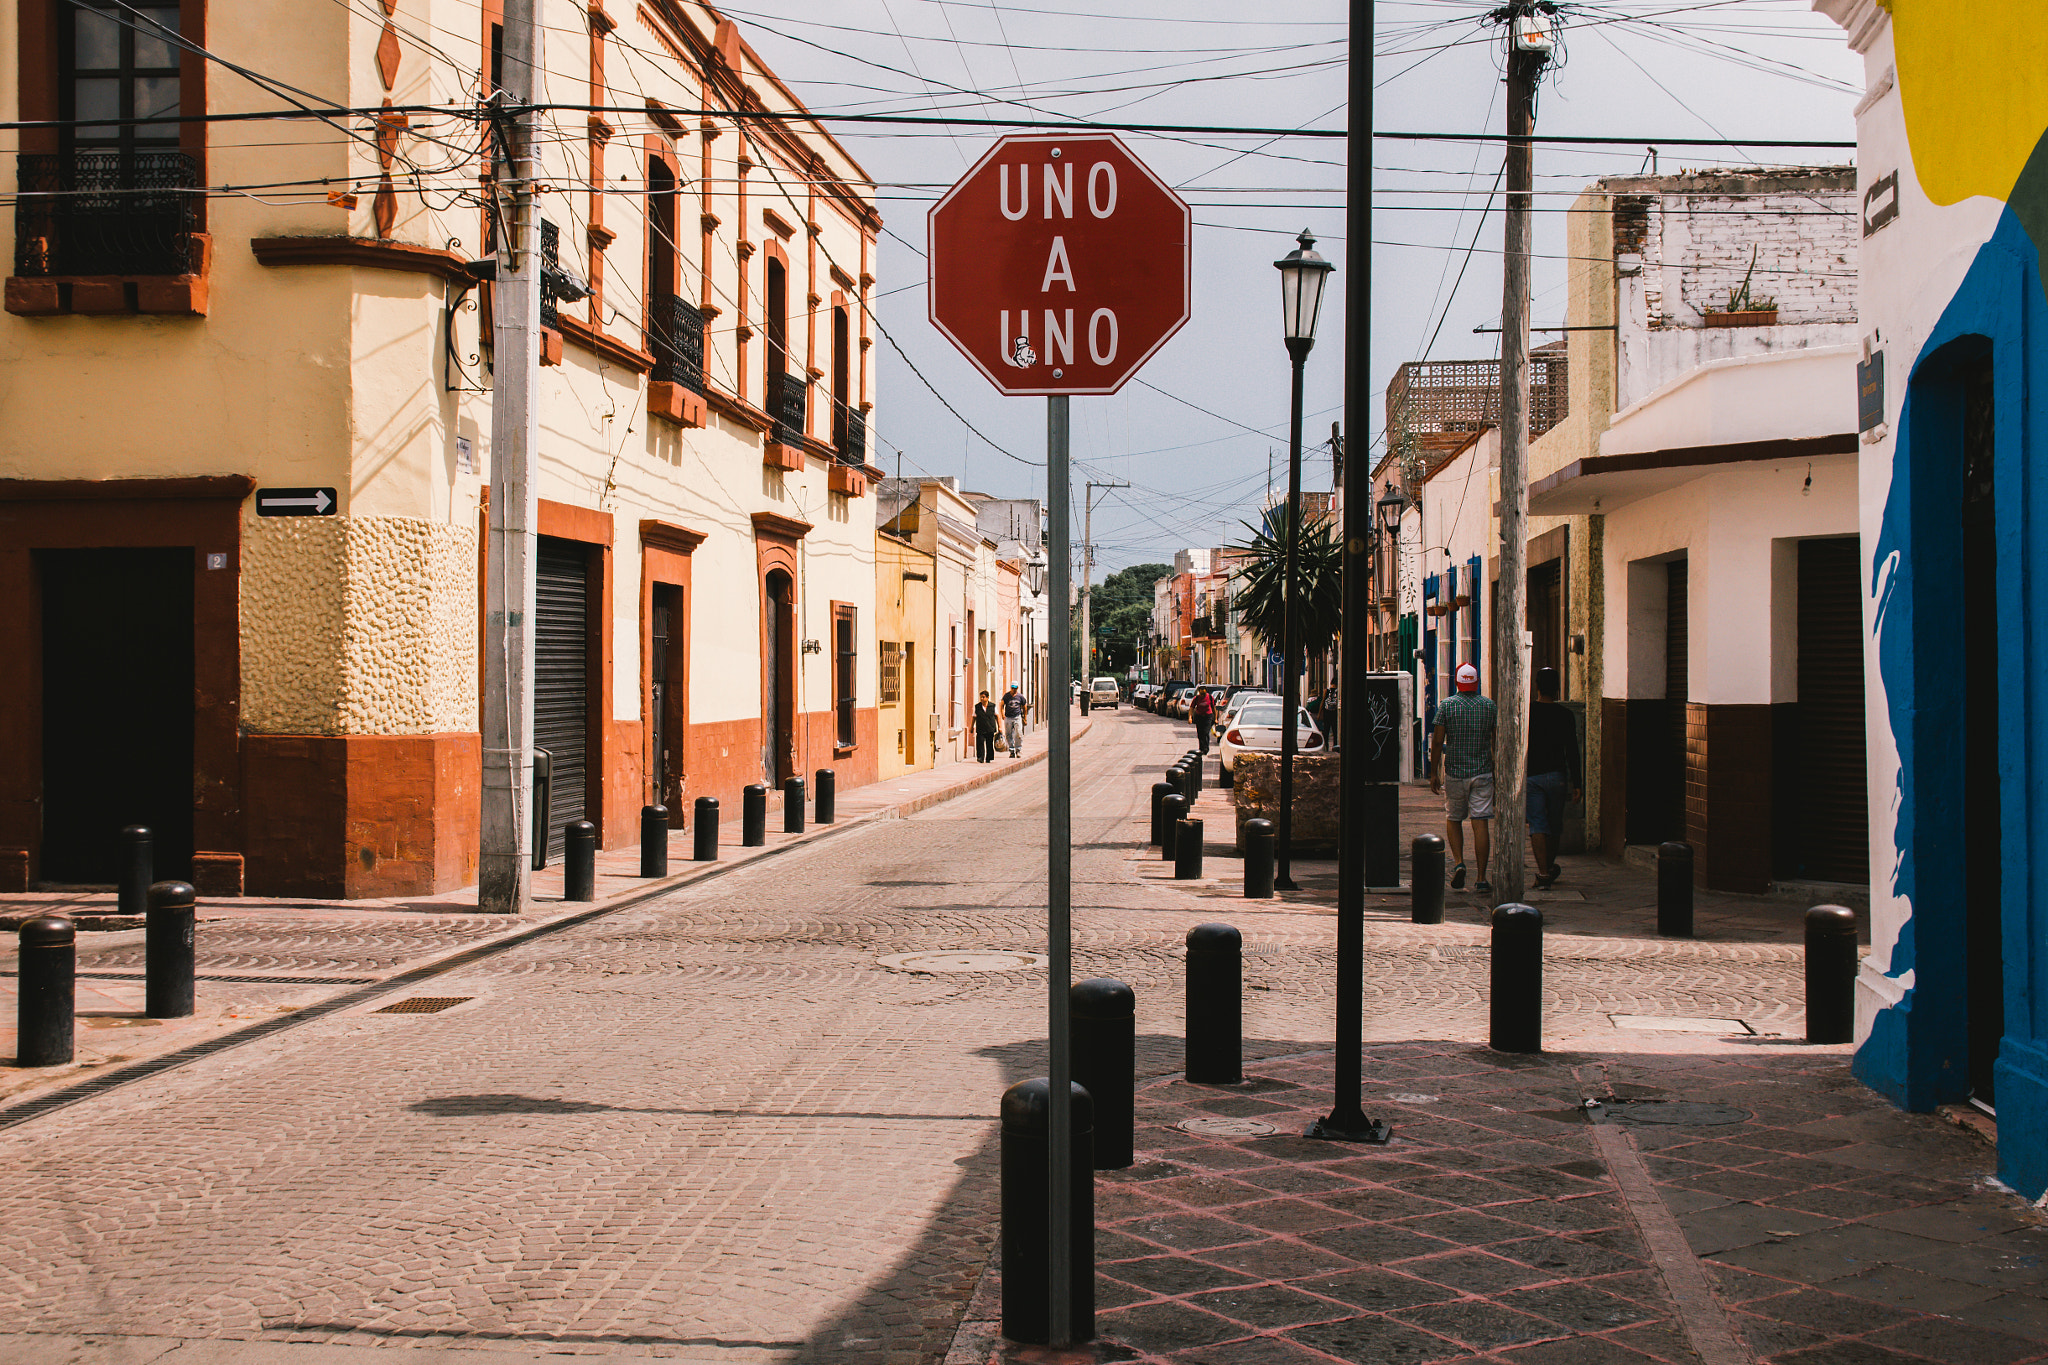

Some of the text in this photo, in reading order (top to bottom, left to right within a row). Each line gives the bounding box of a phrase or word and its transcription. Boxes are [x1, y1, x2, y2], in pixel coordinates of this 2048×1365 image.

[1000, 161, 1118, 221] UNO
[1041, 236, 1076, 292] A
[1000, 307, 1119, 367] UNO
[213, 556, 221, 568] 2
